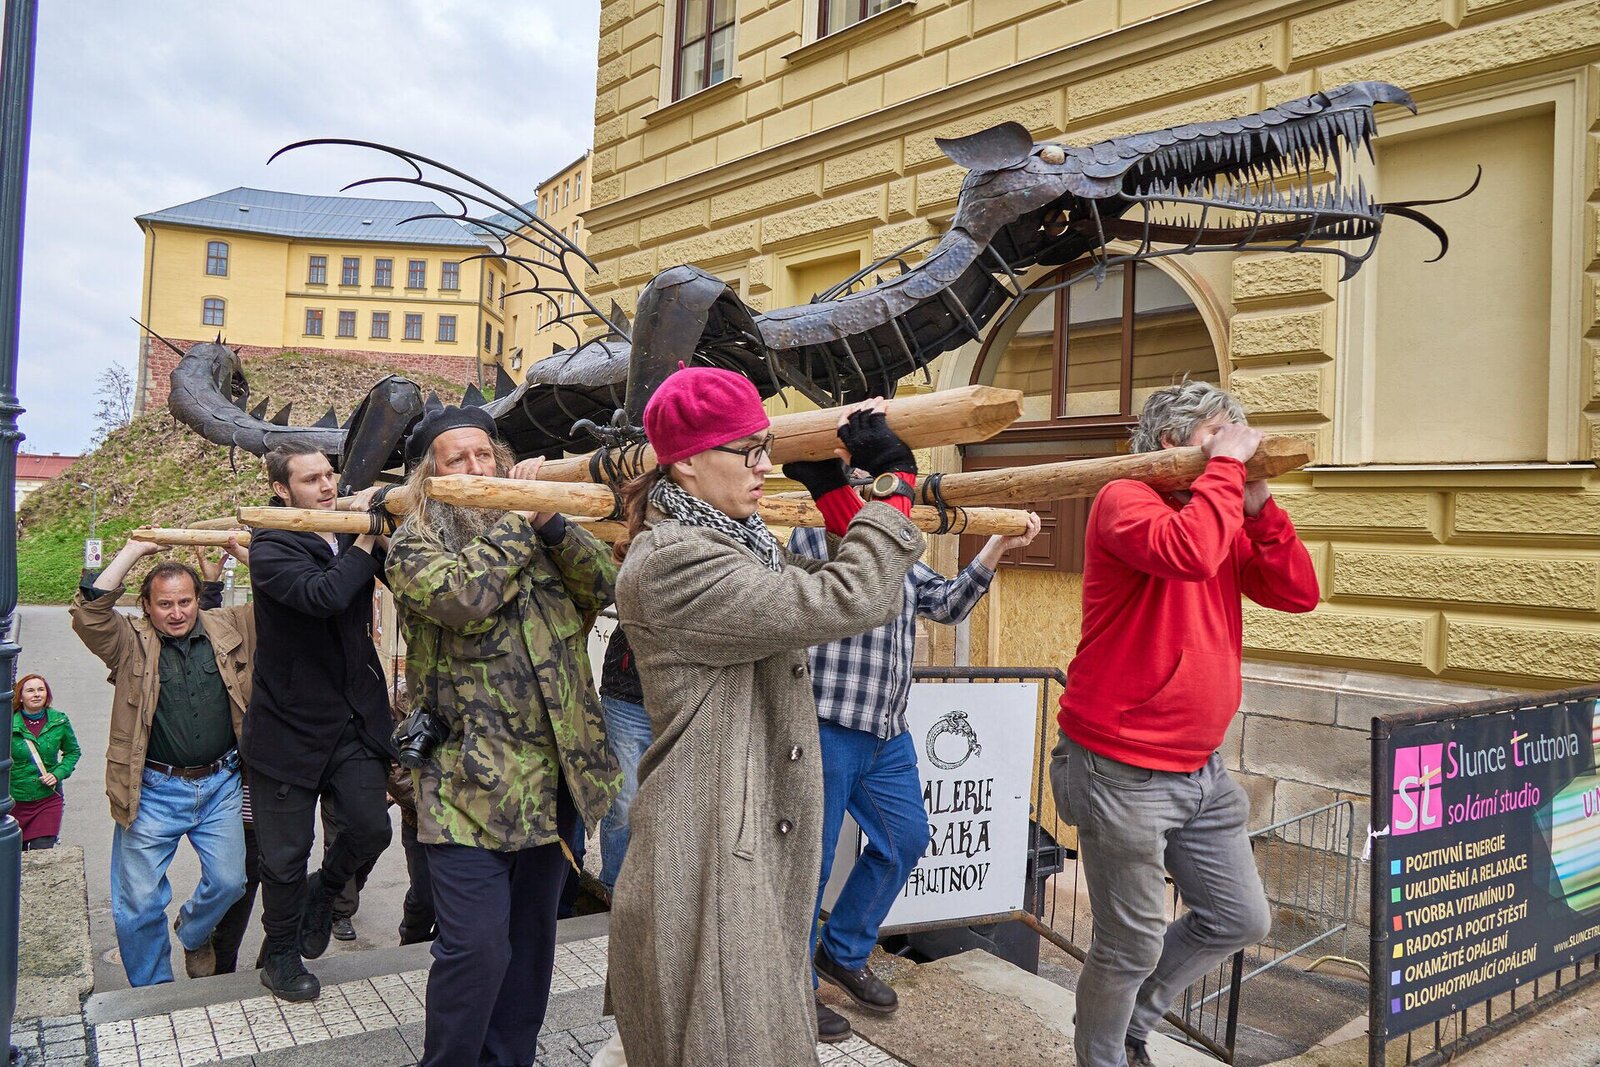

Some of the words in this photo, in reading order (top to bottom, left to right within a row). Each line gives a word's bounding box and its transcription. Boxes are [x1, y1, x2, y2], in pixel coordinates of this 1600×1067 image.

[1446, 741, 1507, 779] Slunce
[1510, 730, 1579, 767] trutnova
[922, 777, 994, 815] ALERIE
[1448, 789, 1498, 825] solární
[1500, 782, 1541, 813] studio
[922, 820, 991, 858] RAKA
[1405, 841, 1463, 874] POZITIVNÍ
[1465, 834, 1506, 860] ENERGIE
[1405, 867, 1469, 901] UKLIDNĚNÍ
[1471, 869, 1478, 885] A
[1480, 853, 1528, 879] RELAXACE
[1405, 901, 1454, 929] TVORBA
[1456, 885, 1506, 915] VITAMÍNU
[1507, 883, 1515, 899] D
[1406, 927, 1454, 956] RADOST
[1455, 924, 1463, 942] A
[1465, 913, 1496, 938] POCIT
[1496, 899, 1528, 927] ŠTĚSTÍ
[1405, 946, 1465, 982] OKAMŽITÉ
[1466, 930, 1509, 962] OPÁLENÍ
[1405, 959, 1497, 1011] DLOUHOTRVAJÍCÍ
[1497, 943, 1538, 975] OPÁLENÍ
